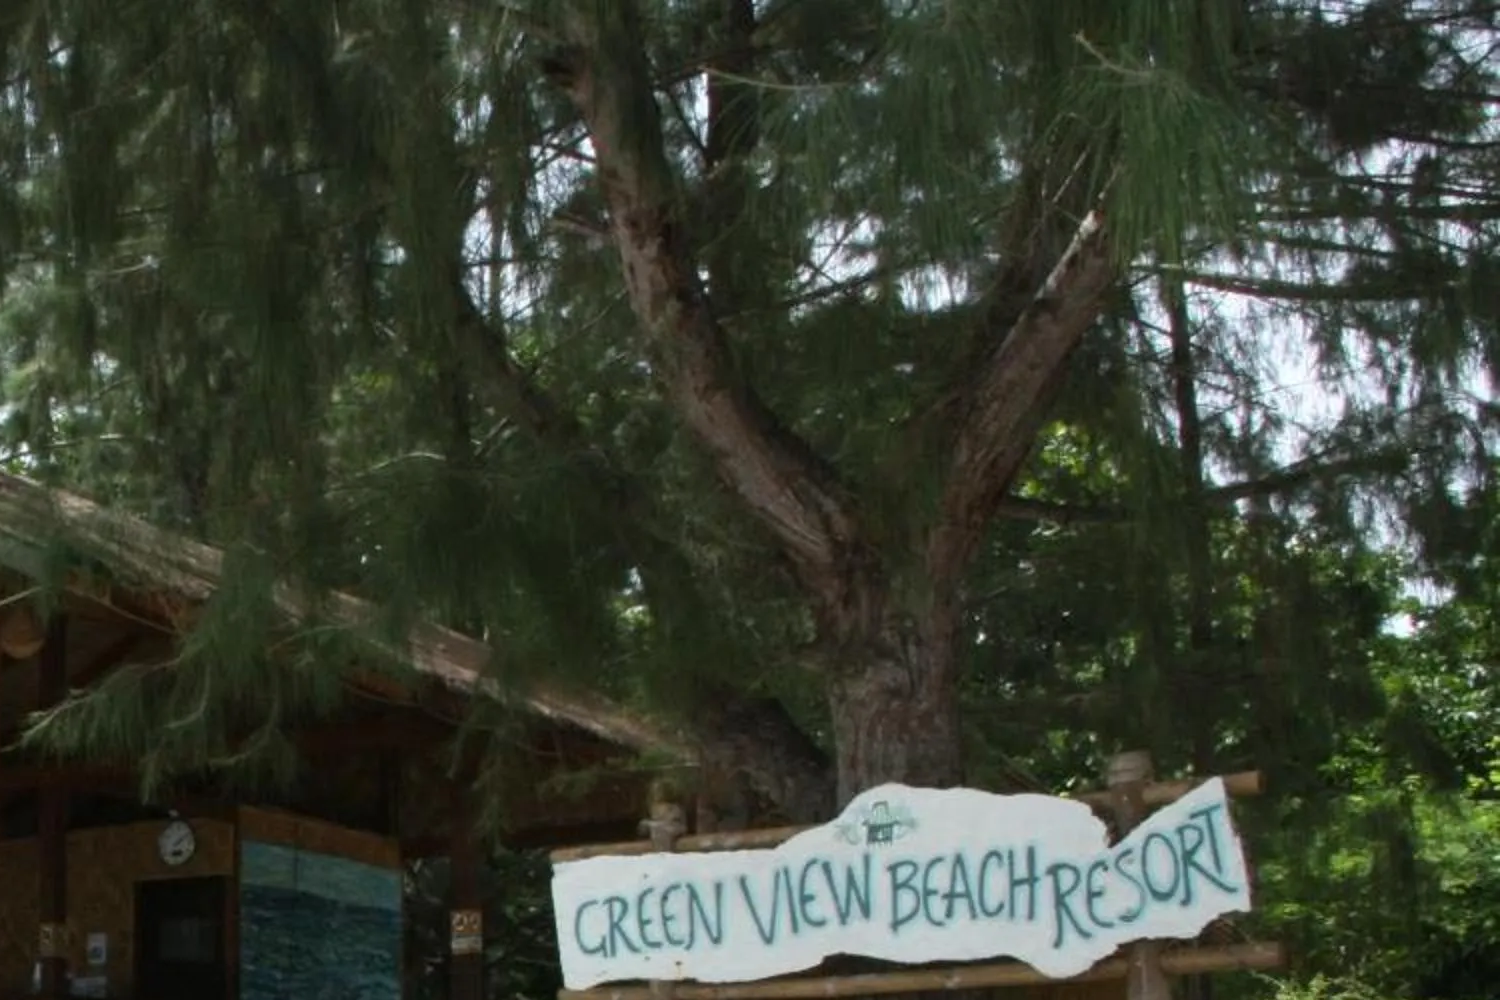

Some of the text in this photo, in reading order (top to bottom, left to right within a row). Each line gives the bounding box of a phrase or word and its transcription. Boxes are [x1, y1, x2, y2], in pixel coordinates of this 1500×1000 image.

[574, 803, 1238, 958] GREEN VIEW BEACH RESORT
